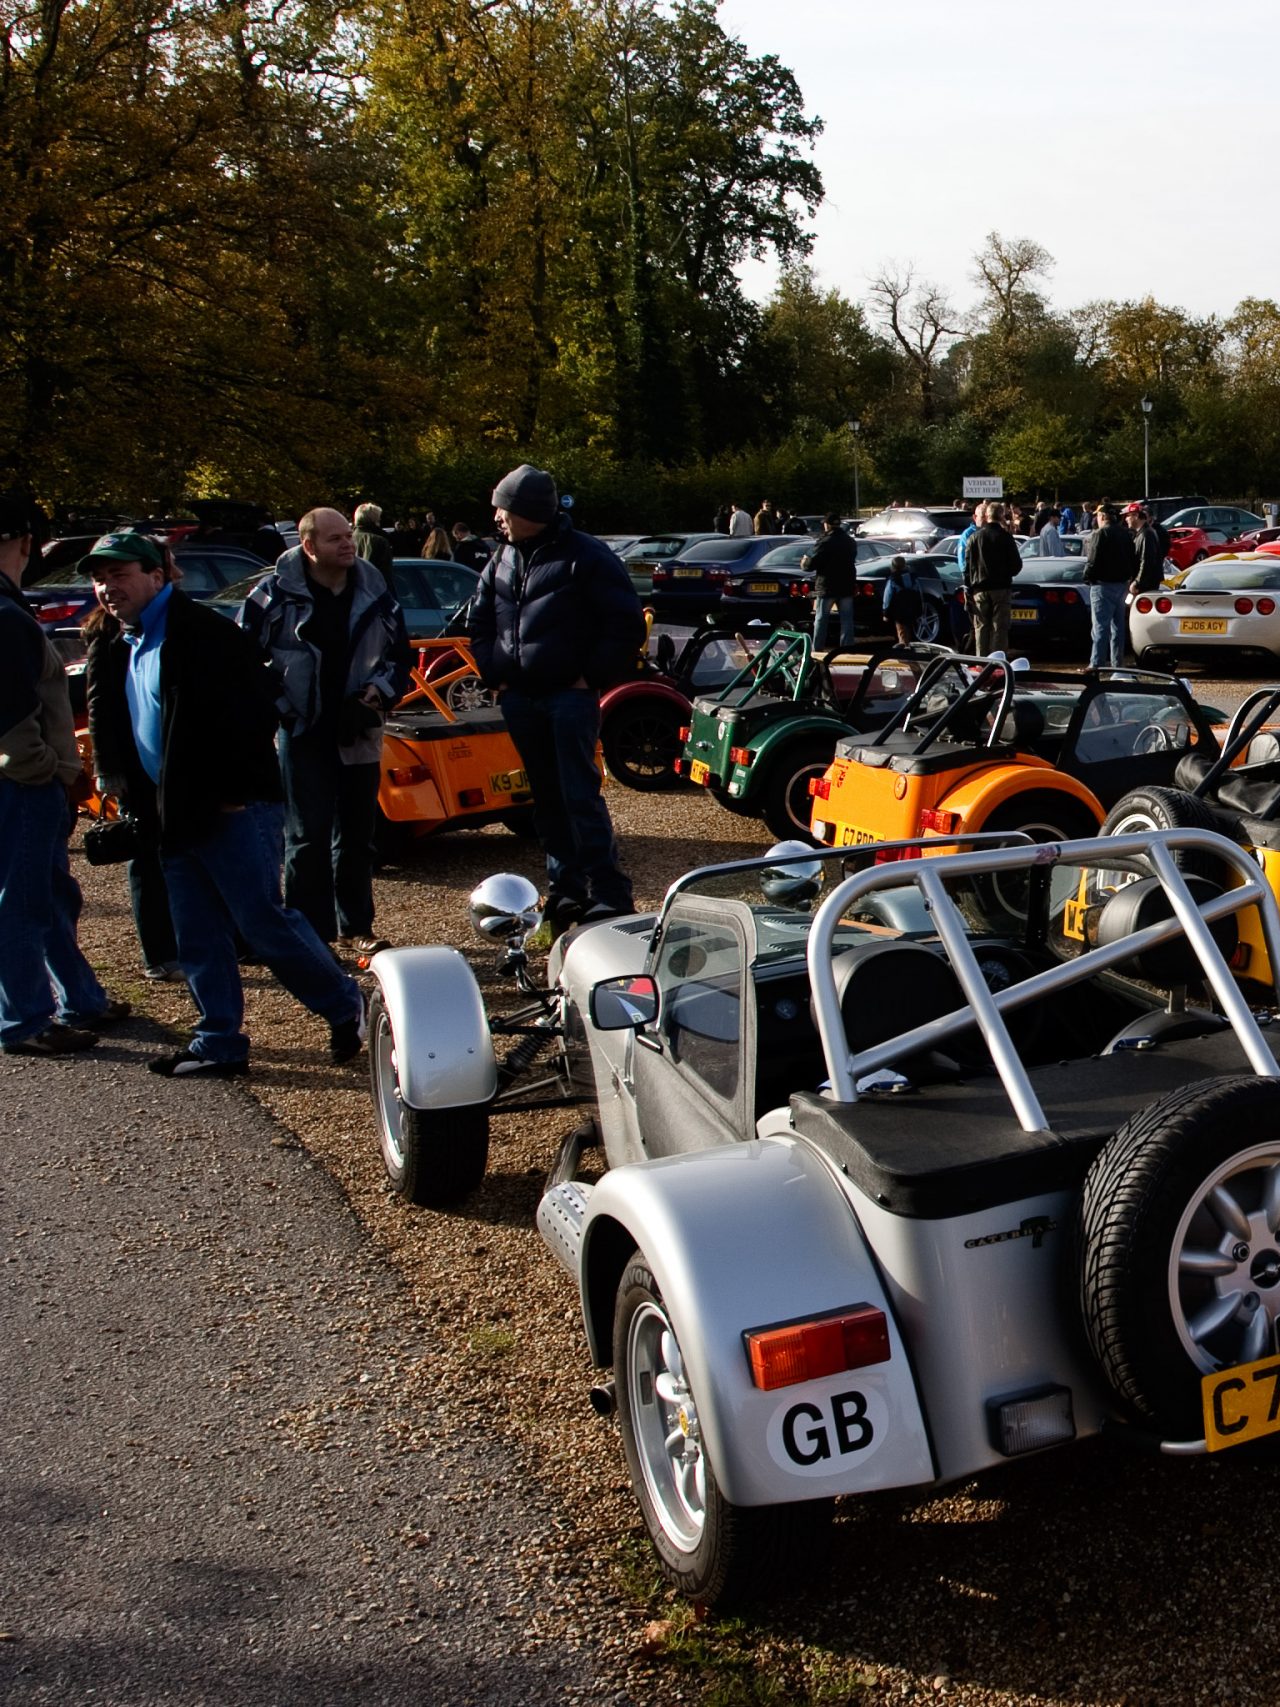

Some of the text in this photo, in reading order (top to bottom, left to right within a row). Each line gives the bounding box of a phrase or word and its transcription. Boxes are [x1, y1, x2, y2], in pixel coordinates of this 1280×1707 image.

[1182, 621, 1224, 630] FJ06 AGY
[490, 773, 512, 791] K9
[842, 827, 855, 846] C7
[966, 1221, 1057, 1248] CATERHAM
[782, 1390, 874, 1467] GB
